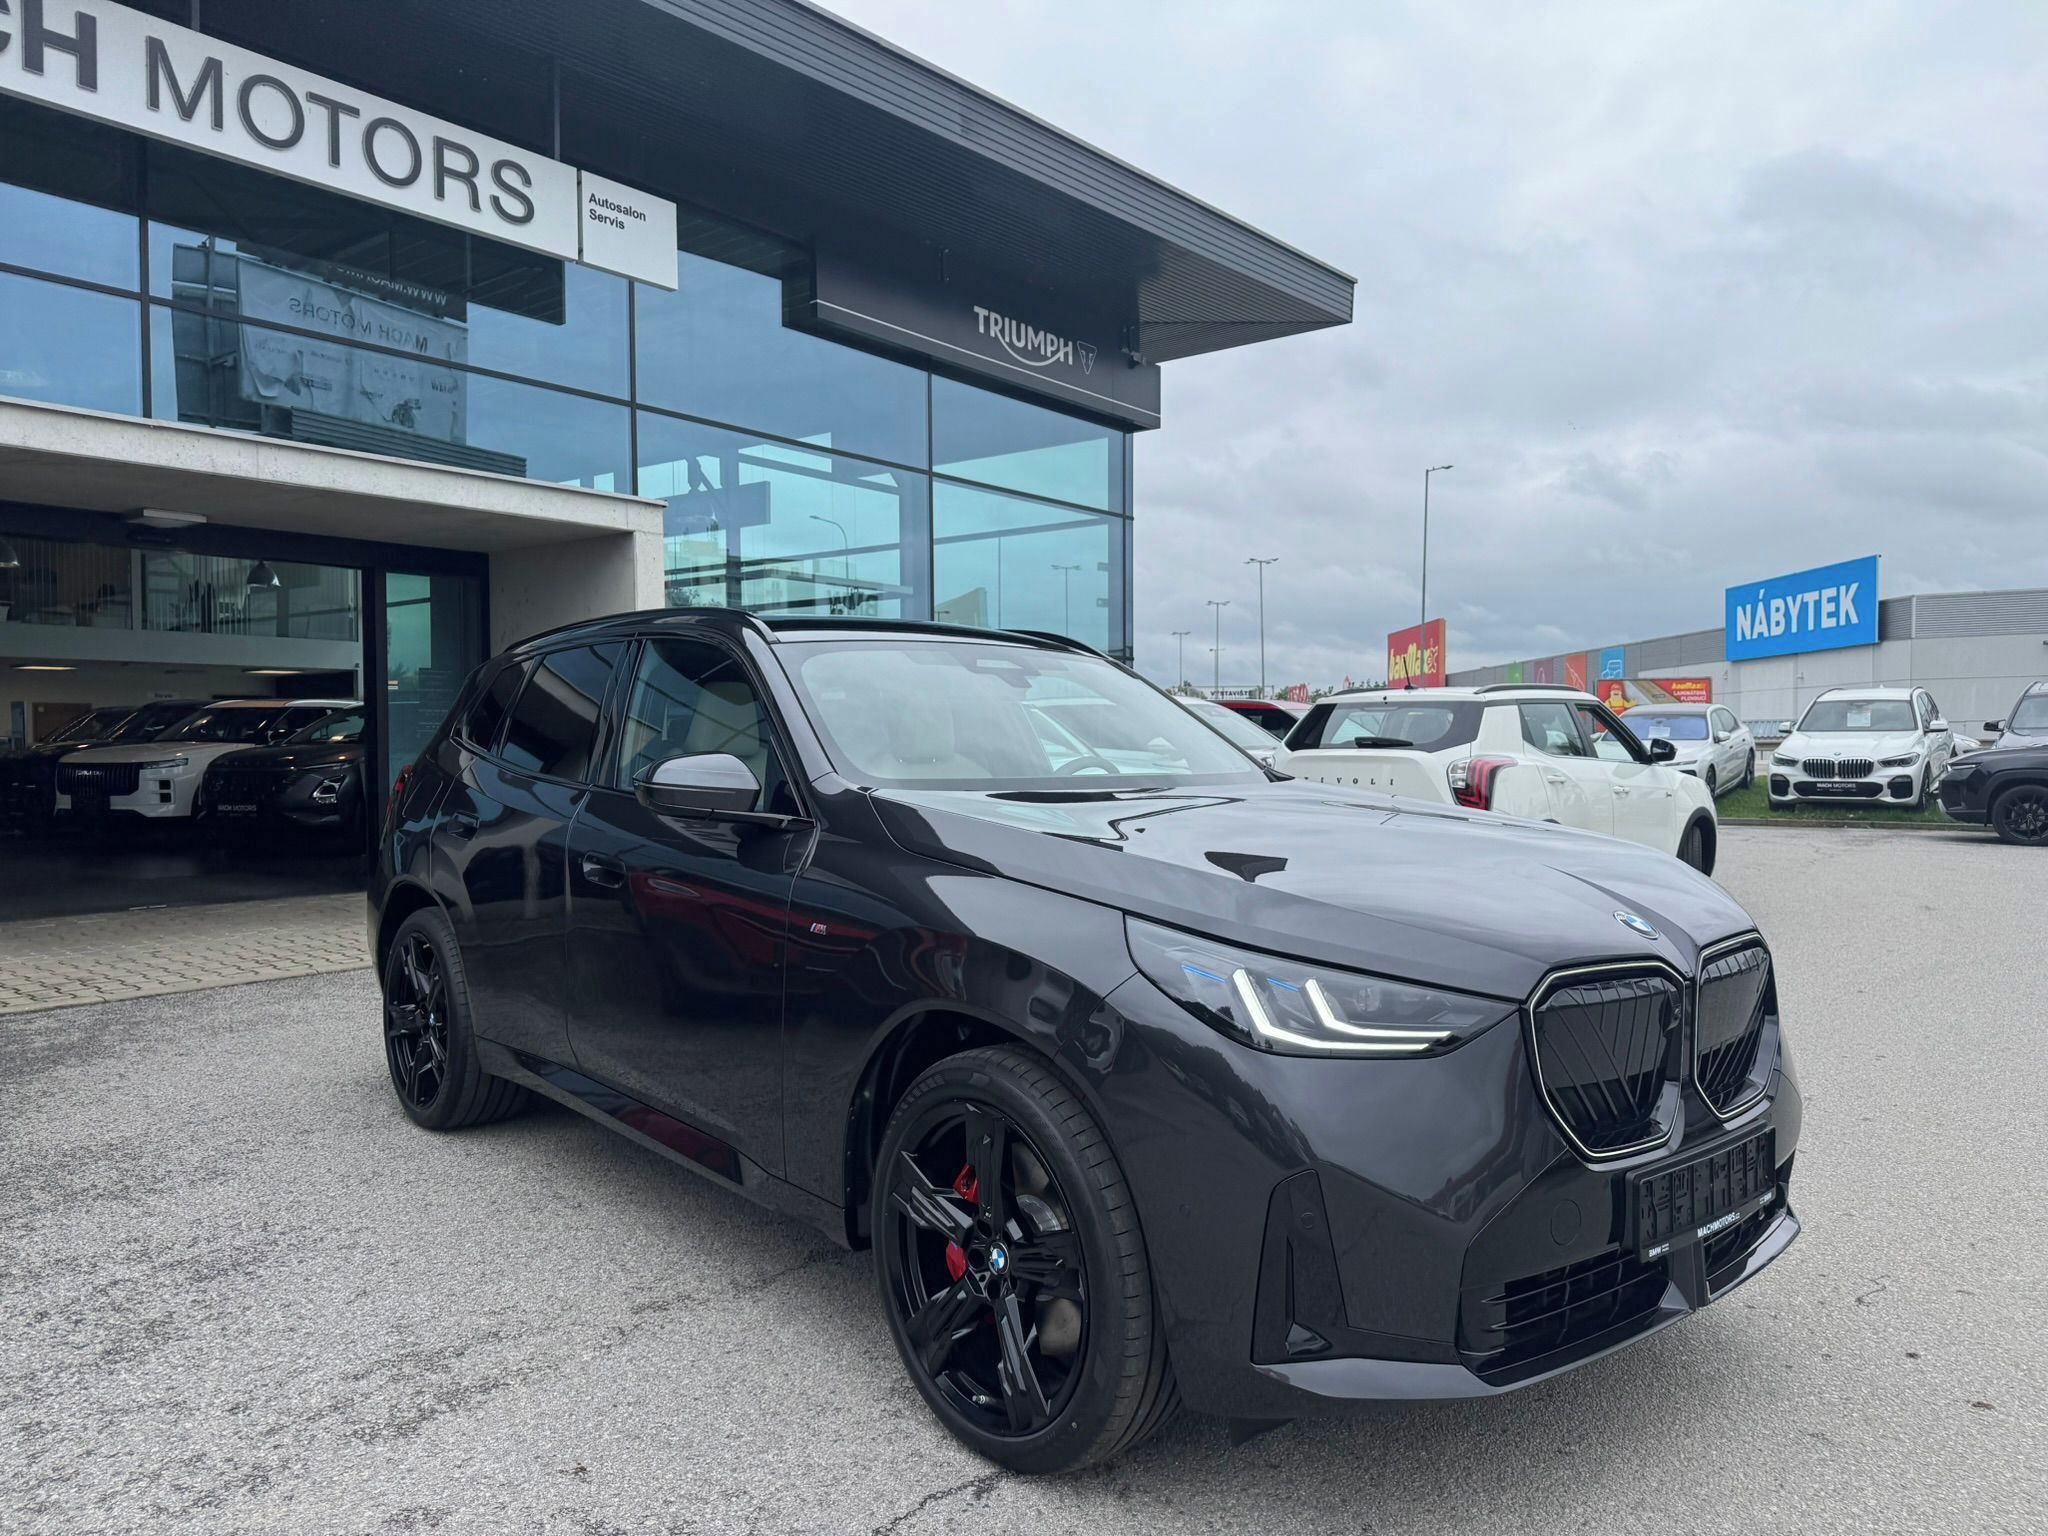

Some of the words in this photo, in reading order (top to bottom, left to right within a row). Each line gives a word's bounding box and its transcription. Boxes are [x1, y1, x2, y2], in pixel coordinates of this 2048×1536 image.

[145, 34, 535, 225] MOTORS
[589, 193, 646, 222] Autosalon
[589, 208, 625, 230] Servis
[973, 305, 1073, 366] TRIUMPH
[1736, 582, 1859, 641] NÁBYTEK
[1649, 1246, 1661, 1257] BMW
